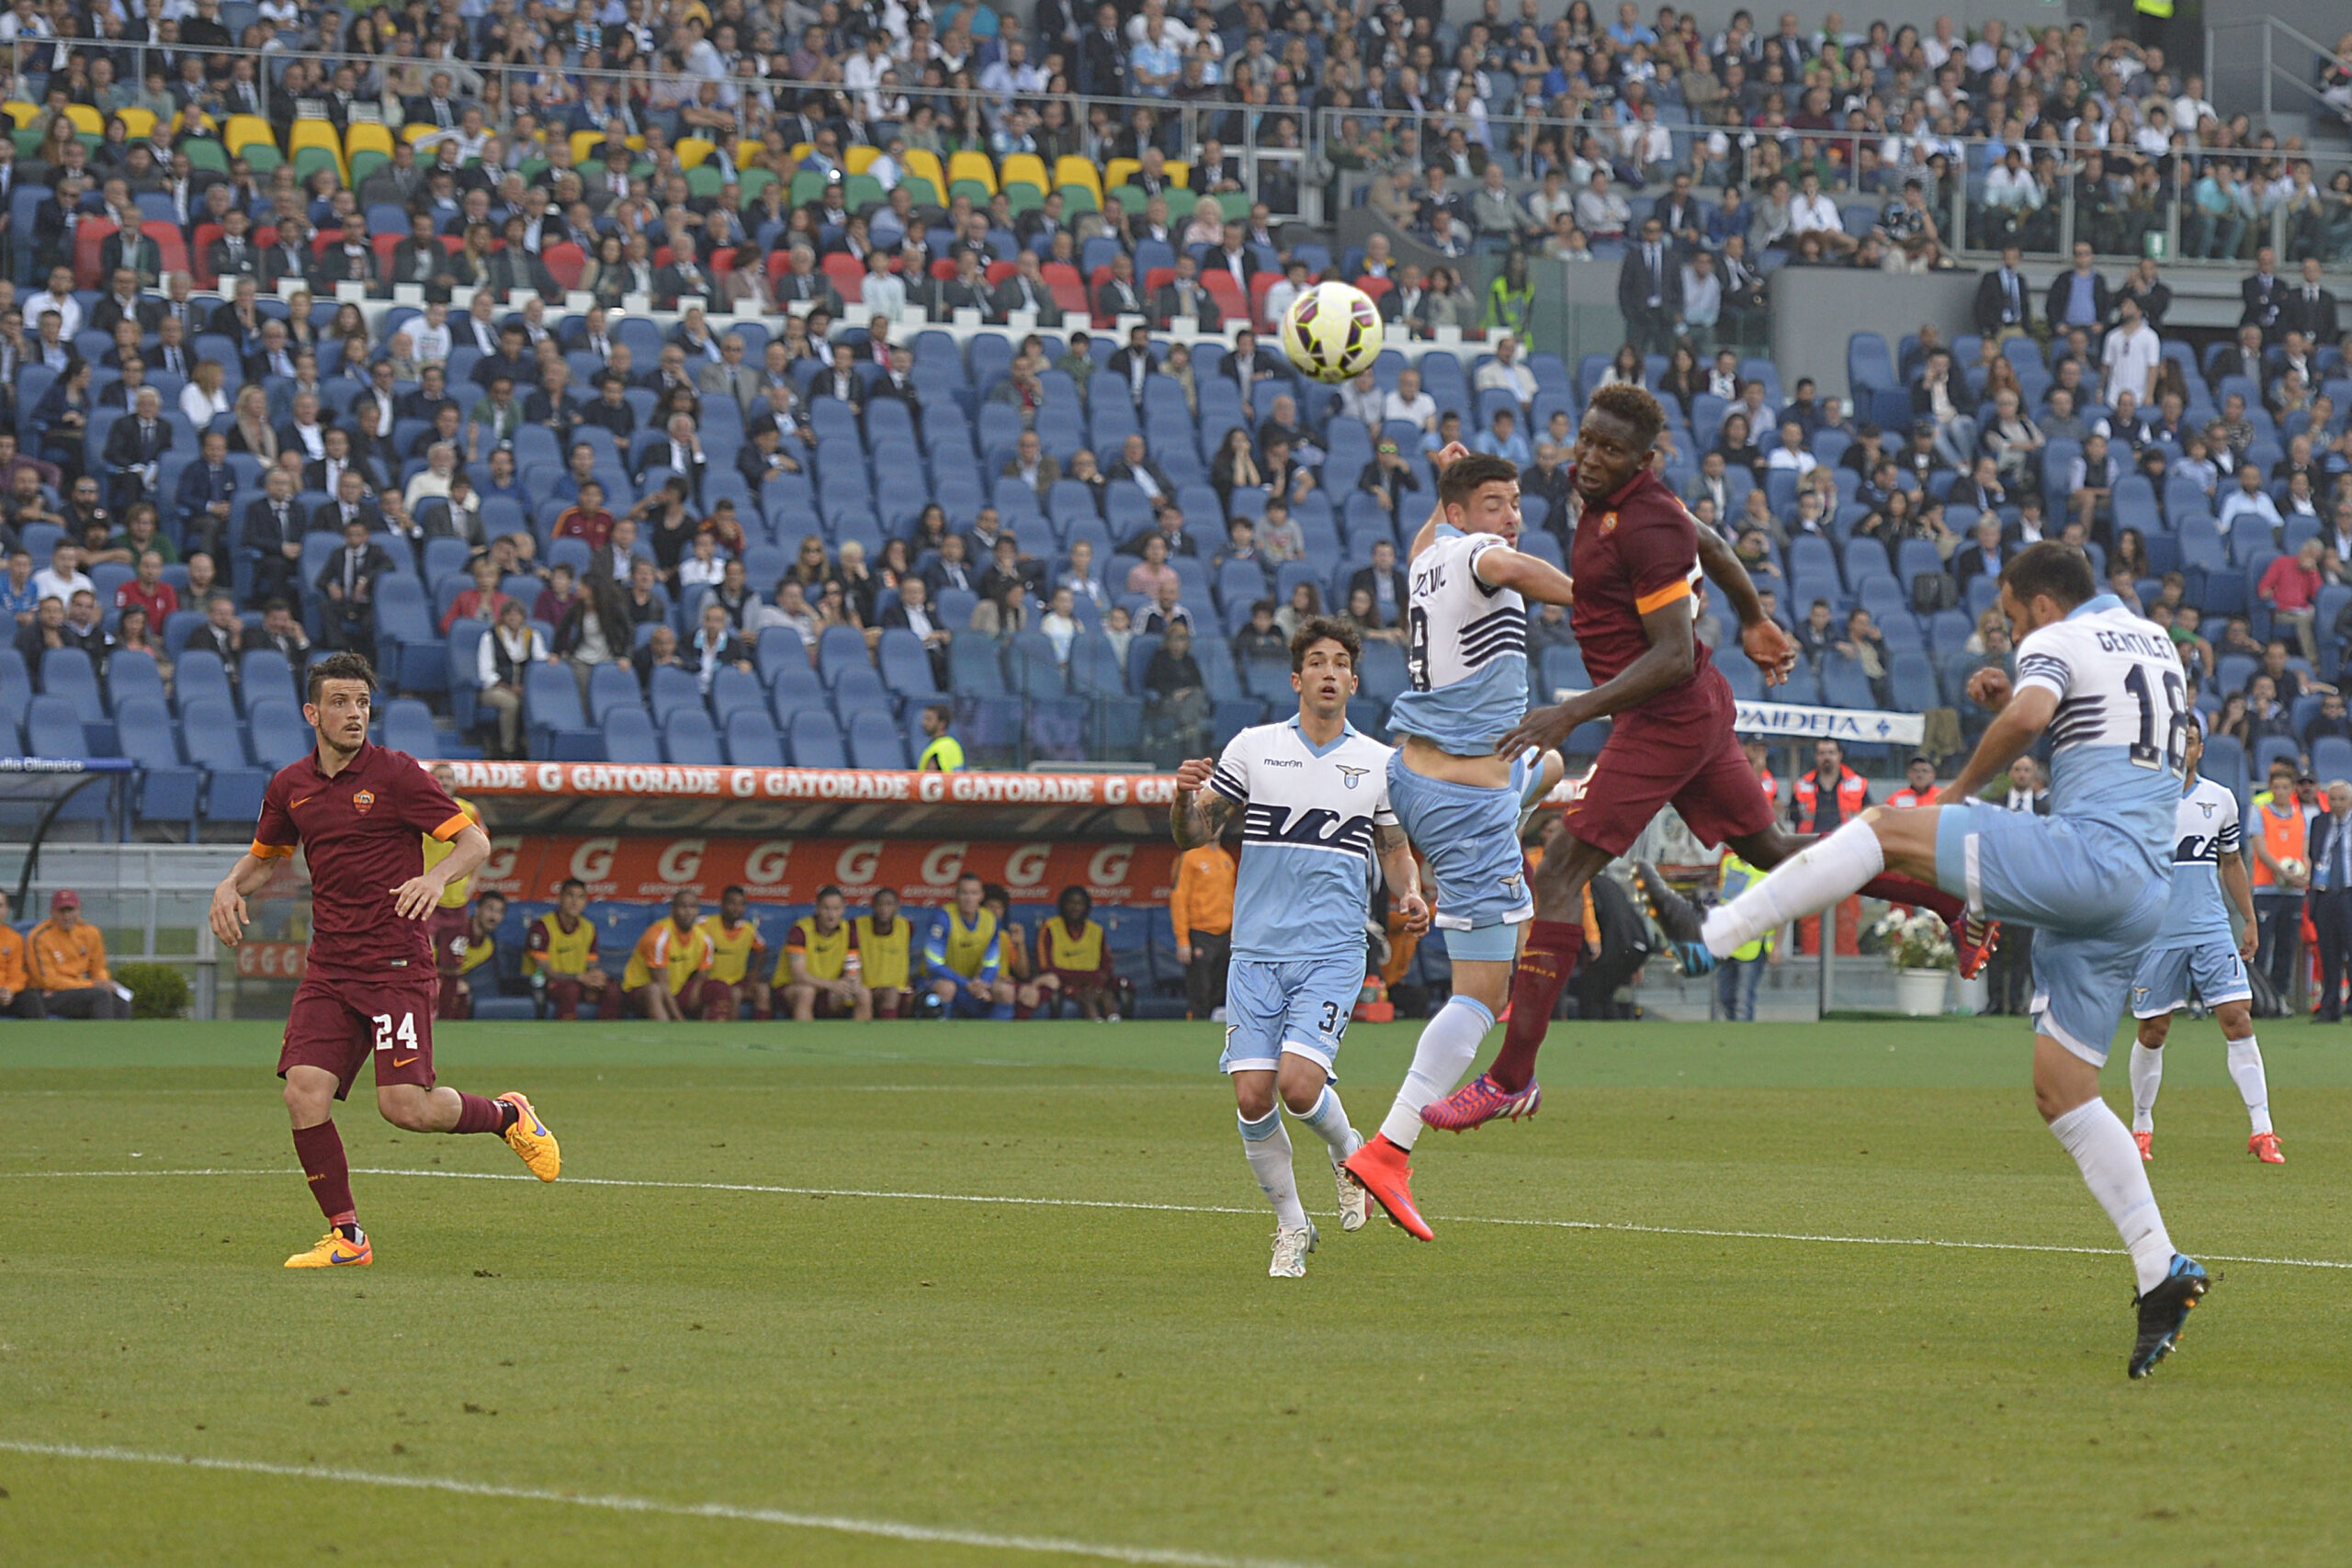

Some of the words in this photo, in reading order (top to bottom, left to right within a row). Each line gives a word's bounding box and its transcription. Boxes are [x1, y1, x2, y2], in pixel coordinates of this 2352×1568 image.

[2124, 663, 2187, 780] 18
[537, 763, 563, 792] G
[571, 765, 720, 795] GATORADE
[730, 768, 756, 797] G
[764, 771, 910, 800] GATORADE
[920, 773, 944, 803] G
[952, 776, 1094, 803] GATORADE
[1104, 776, 1128, 805] G
[1136, 778, 1177, 804] GA
[1264, 758, 1303, 768] macron
[570, 837, 619, 883] G
[658, 839, 707, 884] G
[744, 840, 793, 884] G
[835, 840, 884, 885] G
[922, 841, 968, 886] G
[1005, 843, 1052, 887] G
[1089, 843, 1134, 887] G
[2227, 953, 2240, 978] 7
[372, 1012, 418, 1051] 24
